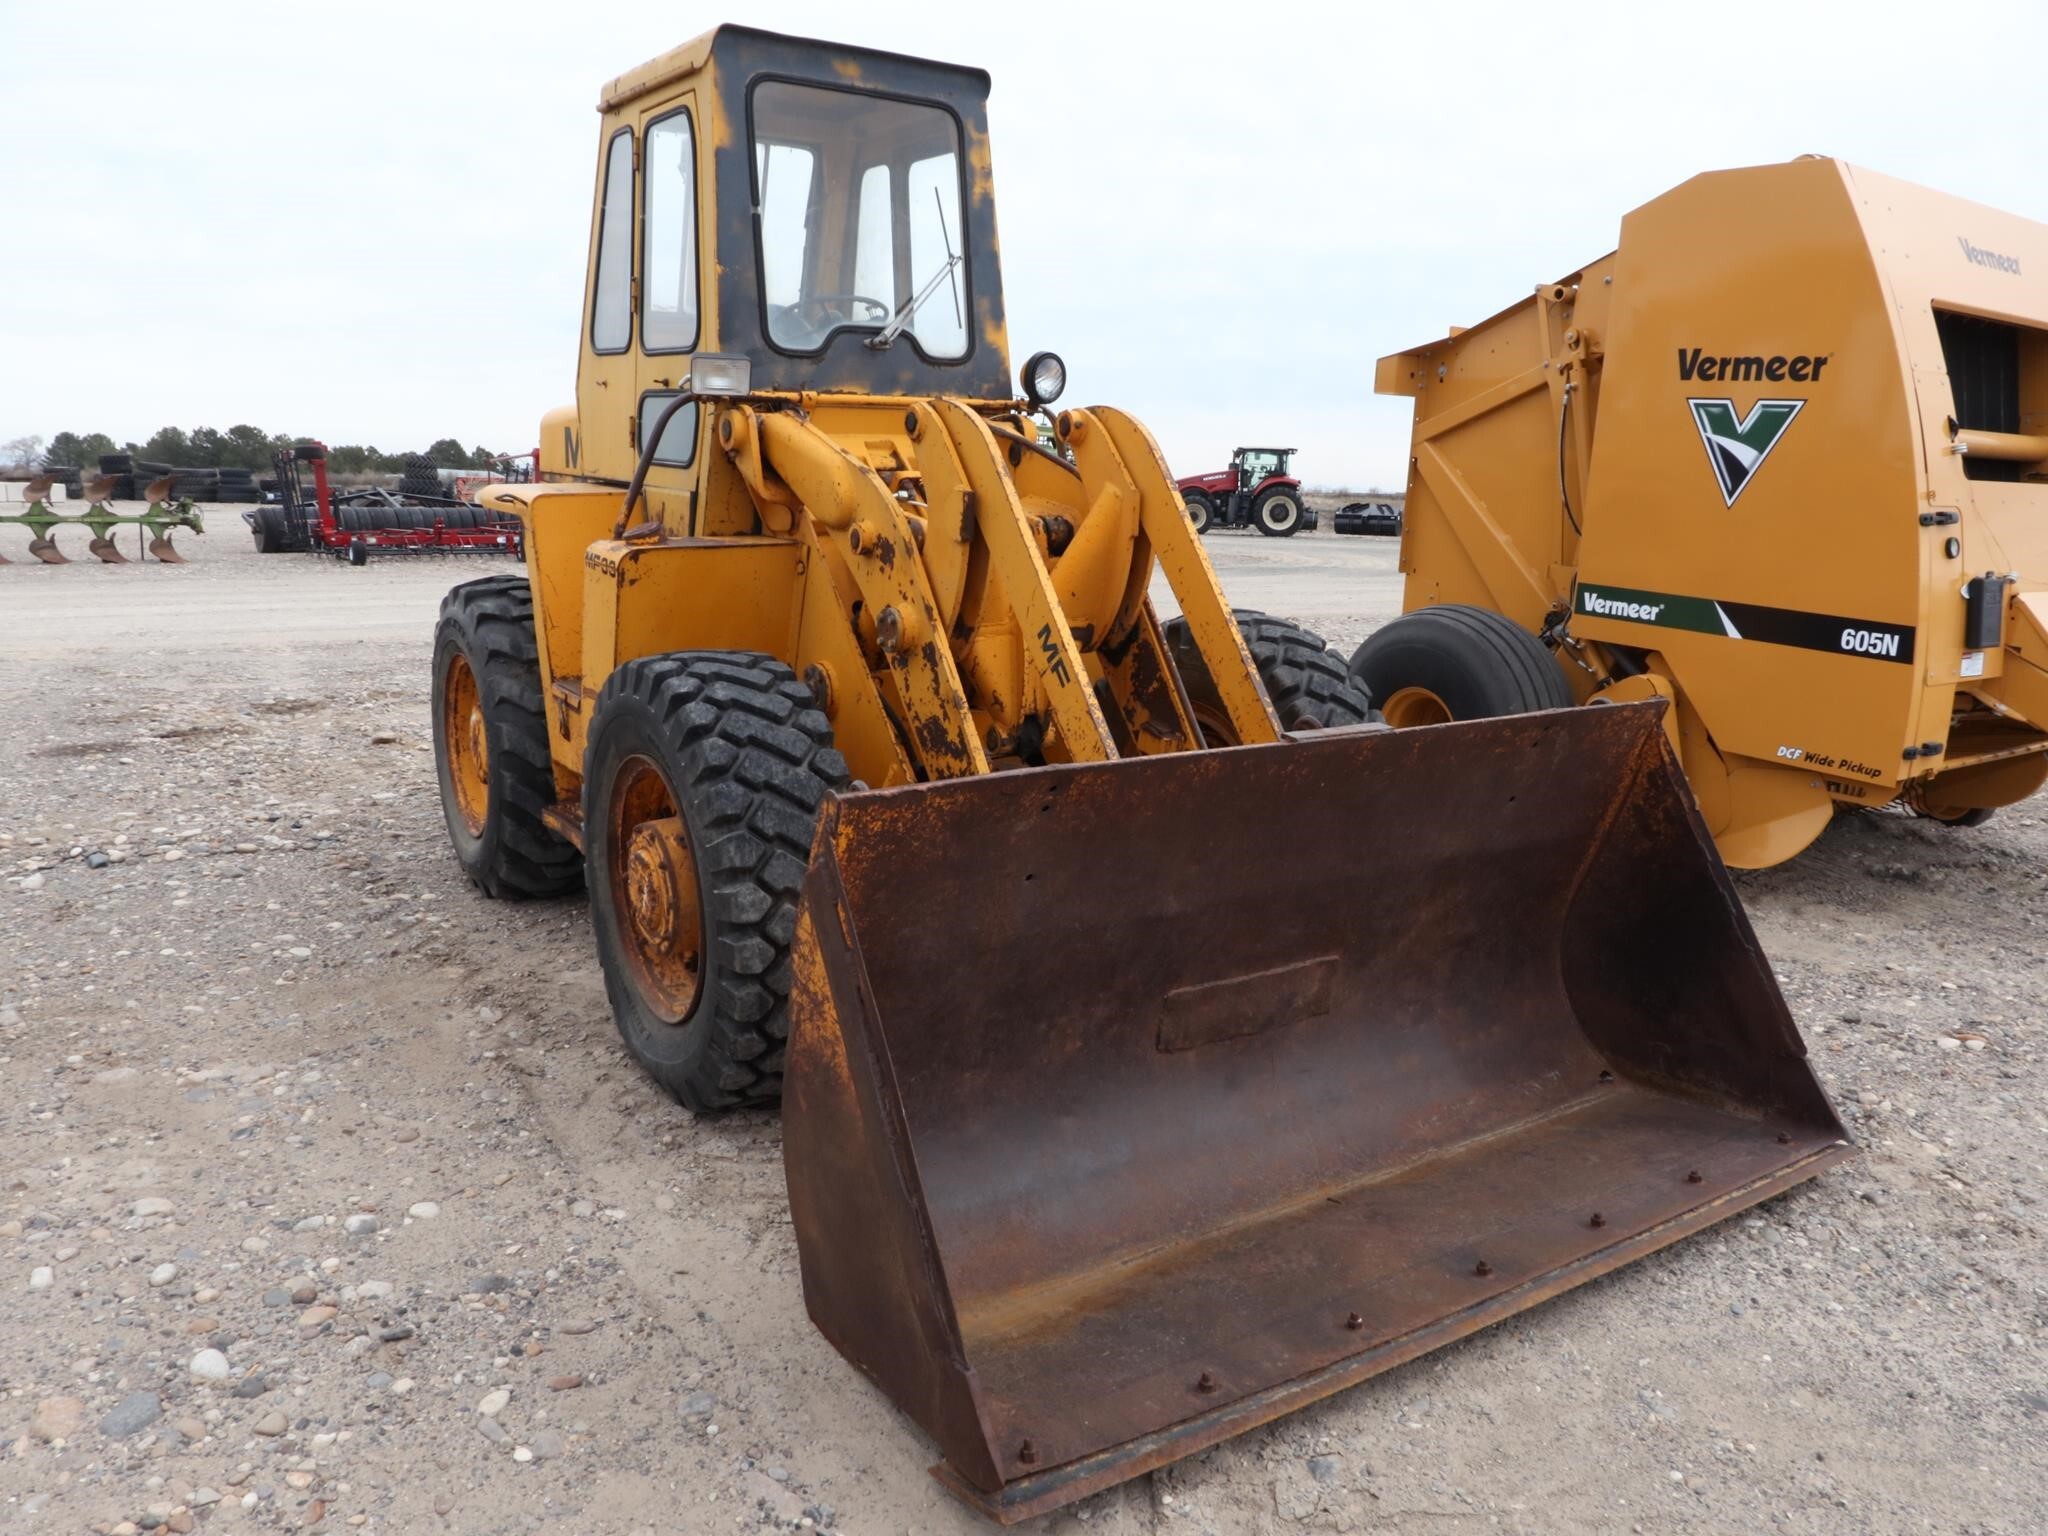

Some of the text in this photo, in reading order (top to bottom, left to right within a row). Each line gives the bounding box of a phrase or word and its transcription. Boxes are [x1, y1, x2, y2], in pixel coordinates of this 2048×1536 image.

[1957, 236, 2021, 276] Vermeer
[1677, 348, 1829, 382] Vermeer
[1583, 592, 1900, 657] Vermeer 605N
[1037, 622, 1071, 688] MF
[1777, 746, 1882, 779] DCF Wide Pickup
